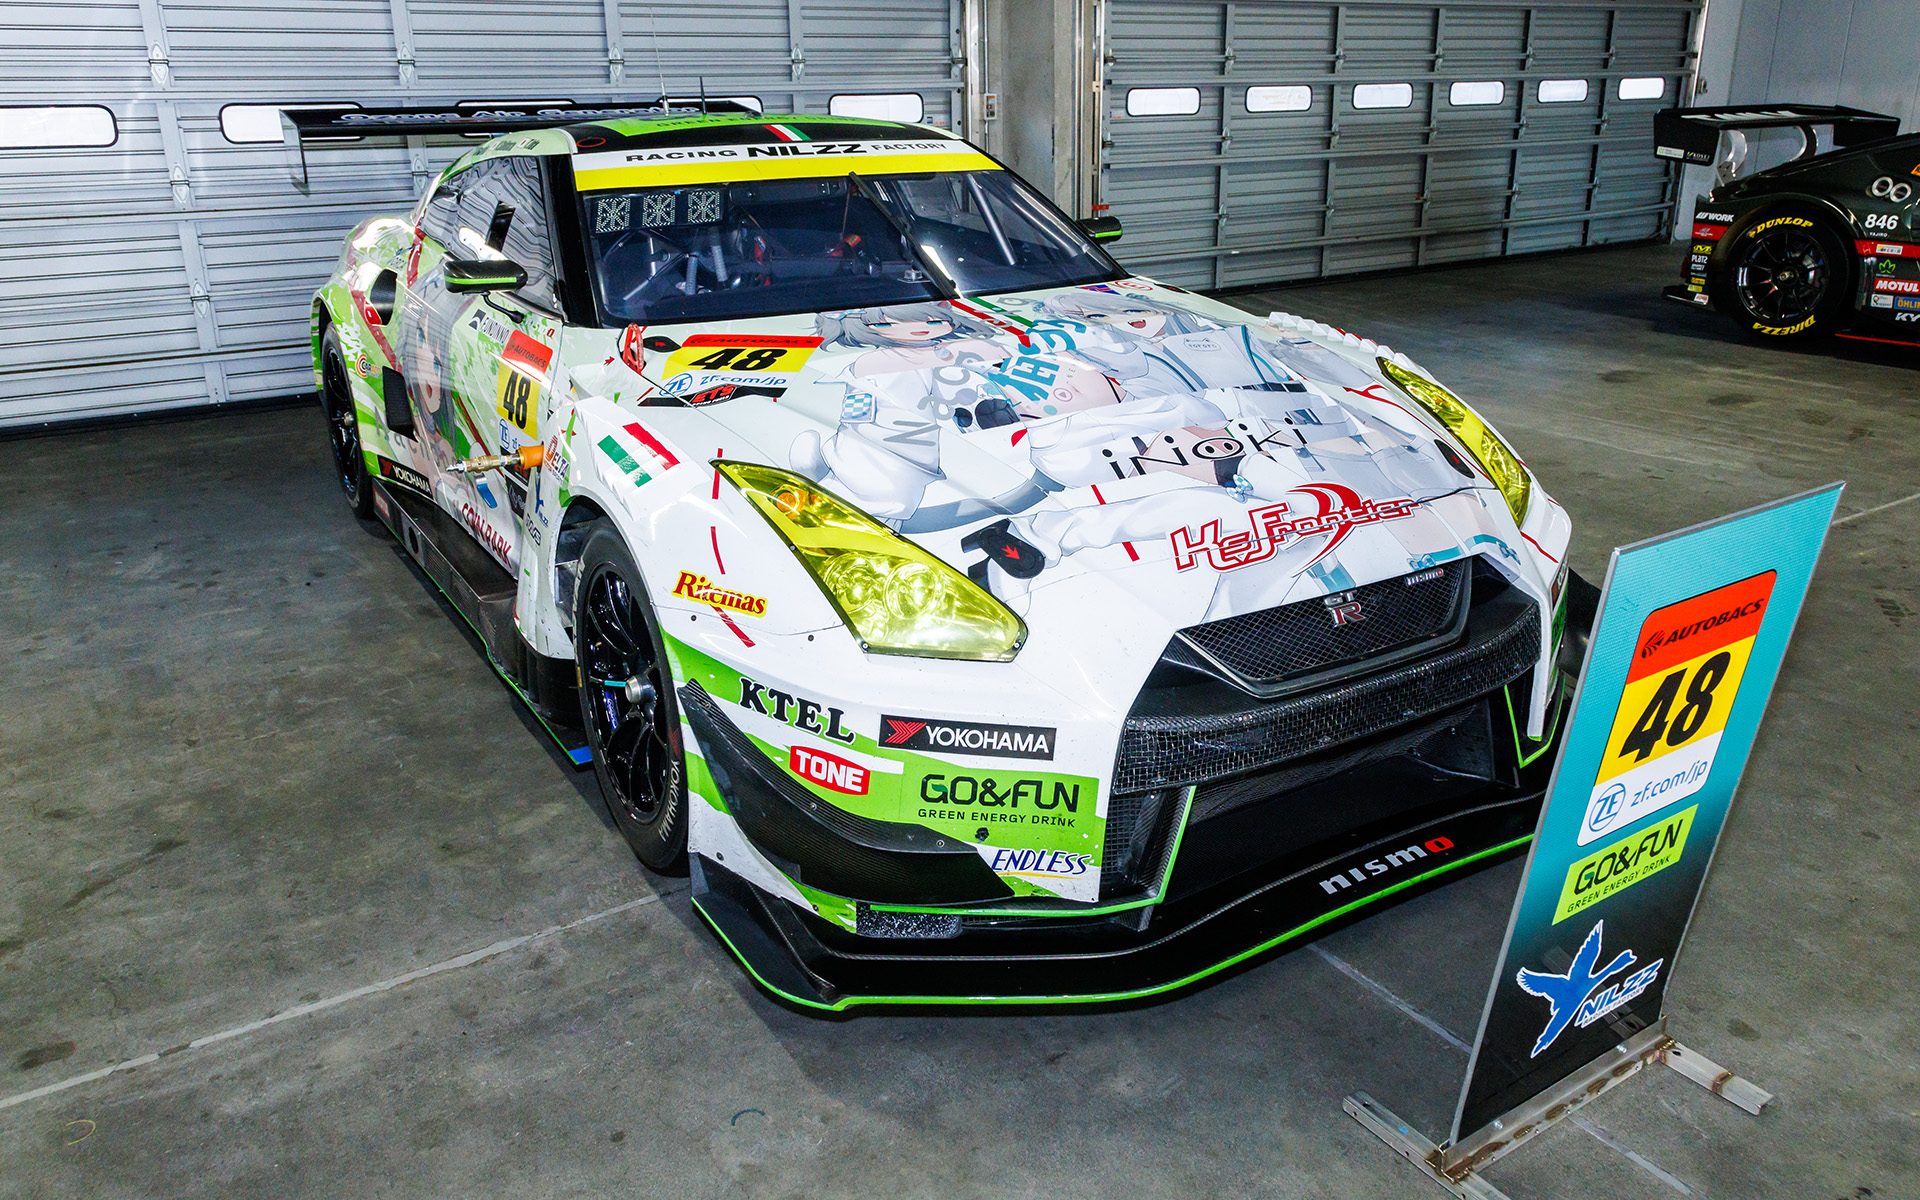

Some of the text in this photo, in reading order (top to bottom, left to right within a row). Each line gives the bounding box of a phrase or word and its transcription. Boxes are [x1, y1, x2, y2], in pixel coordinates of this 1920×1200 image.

[626, 143, 947, 162] RACING NILZZ FACTORY
[1708, 213, 1735, 222] WORK
[1757, 217, 1814, 233] DUNLOP
[1864, 213, 1899, 230] 846
[1875, 280, 1919, 292] MOTUL
[1752, 314, 1816, 336] DIREZZA
[714, 337, 816, 345] AUTOBACS
[513, 345, 547, 369] AUTOBACS
[688, 348, 788, 371] 48
[692, 384, 738, 403] ETS
[700, 375, 787, 386] zf.com/jp
[503, 369, 531, 430] 48
[393, 464, 431, 494] YOKOHAMA
[1404, 568, 1444, 587] nismo
[1663, 599, 1764, 647] AUTOBACS
[739, 678, 855, 744] KTEL
[1618, 651, 1731, 764] 48
[926, 725, 1049, 754] YOKOHAMA
[795, 748, 864, 793] TONE
[657, 760, 681, 842] YOKOHAMA
[920, 773, 1080, 813] GO&FUN
[1589, 760, 1708, 830] ZF zf.com/jp
[918, 808, 1076, 828] GREEN ENERGY DRINK
[991, 849, 1092, 874] ENDLESS
[1319, 836, 1455, 895] nismo
[1574, 819, 1683, 895] GO&FUN
[1567, 854, 1671, 913] GREEN ENERGY DRINK
[1574, 958, 1663, 1026] NILZZ
